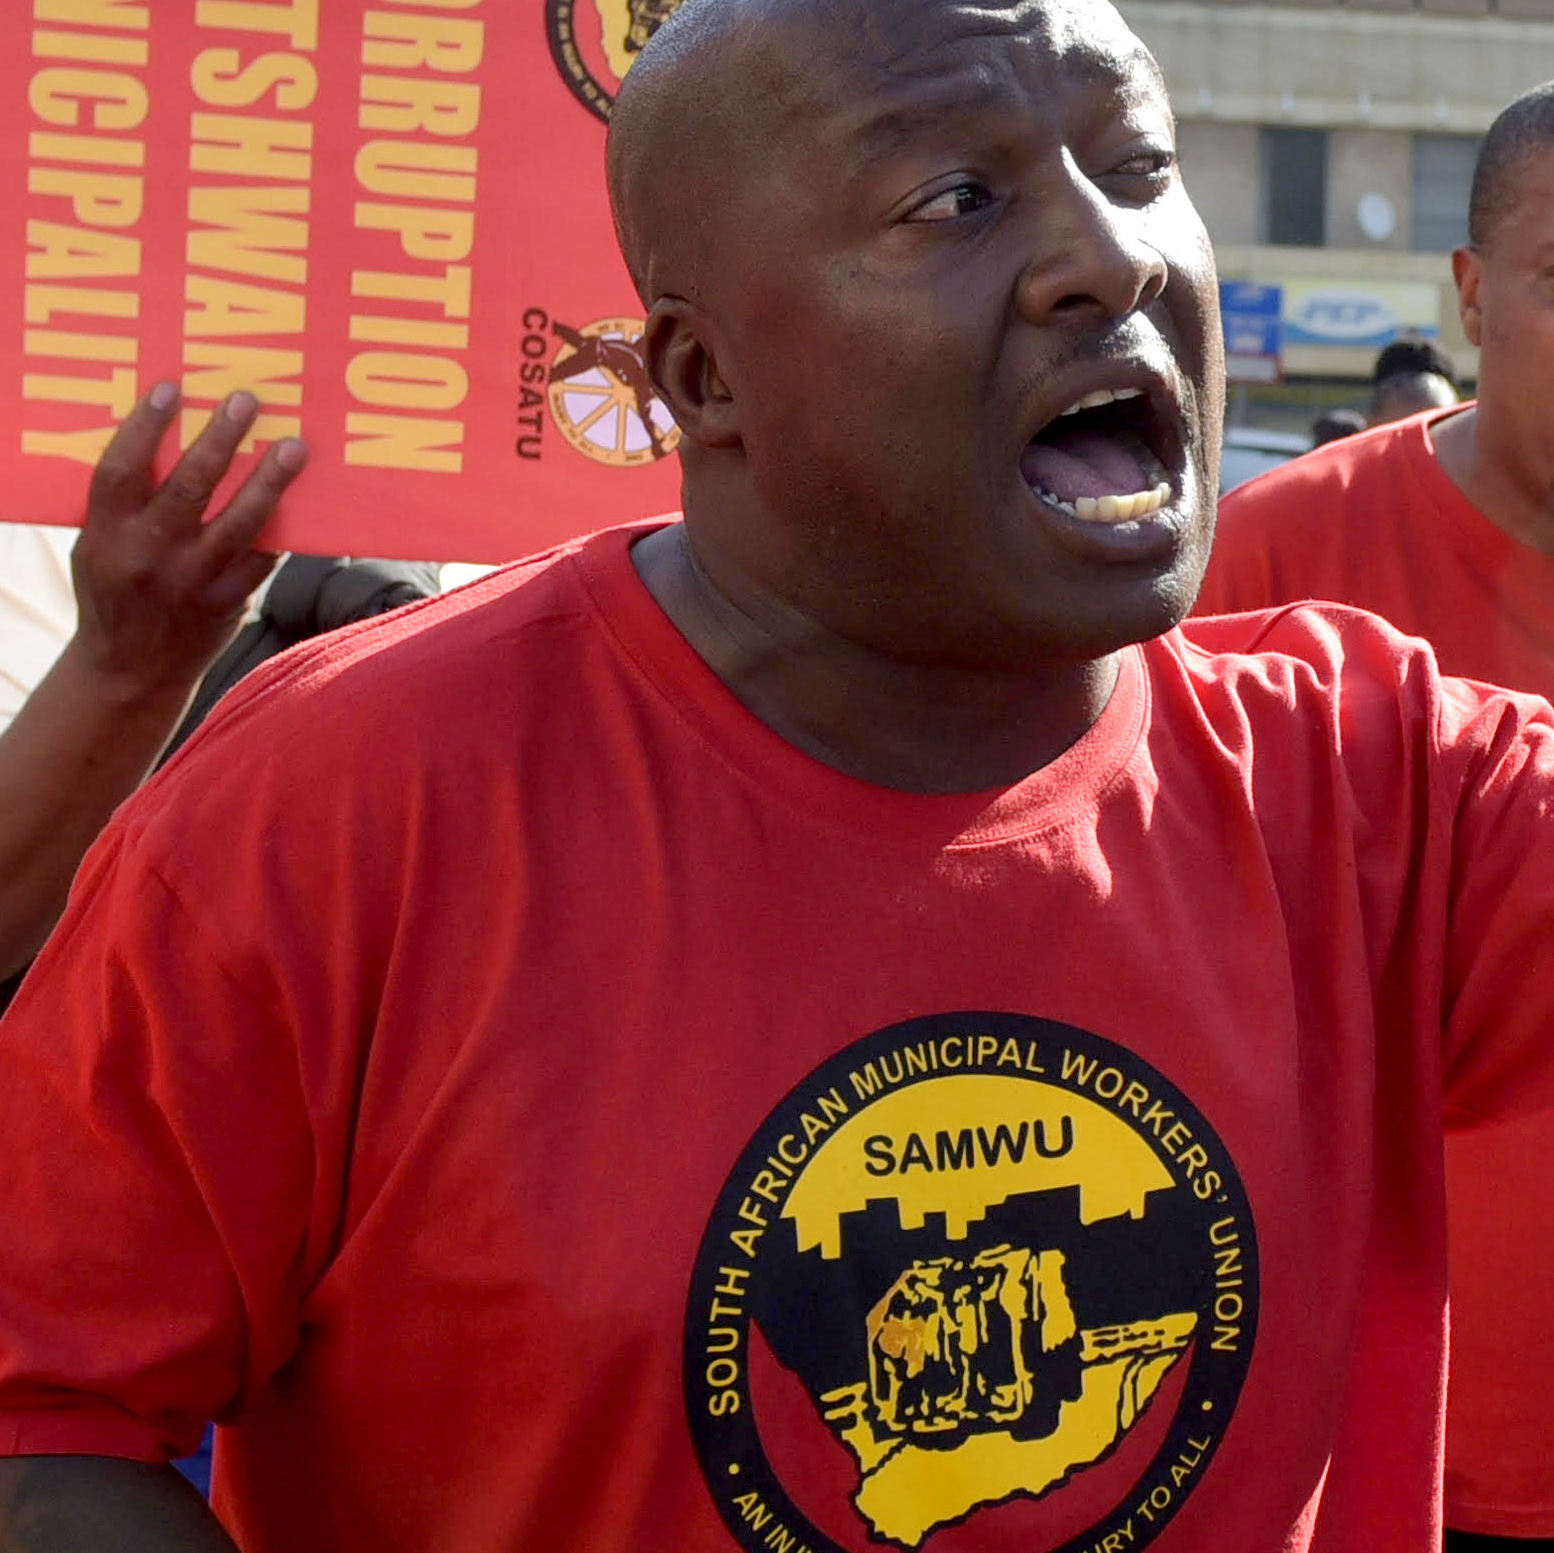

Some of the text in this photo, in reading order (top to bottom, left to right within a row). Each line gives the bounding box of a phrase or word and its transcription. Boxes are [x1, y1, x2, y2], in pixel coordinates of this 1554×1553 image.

[344, 0, 487, 473] RRUPTION
[516, 307, 548, 461] COSATU
[863, 1115, 1075, 1177] SAMWU
[705, 1035, 1244, 1417] SOUTH AFRICAN MUNICIPAL WORKERS' UNION
[732, 1492, 774, 1532] AN
[1136, 1485, 1171, 1521] TO
[1170, 1435, 1211, 1488] ALL
